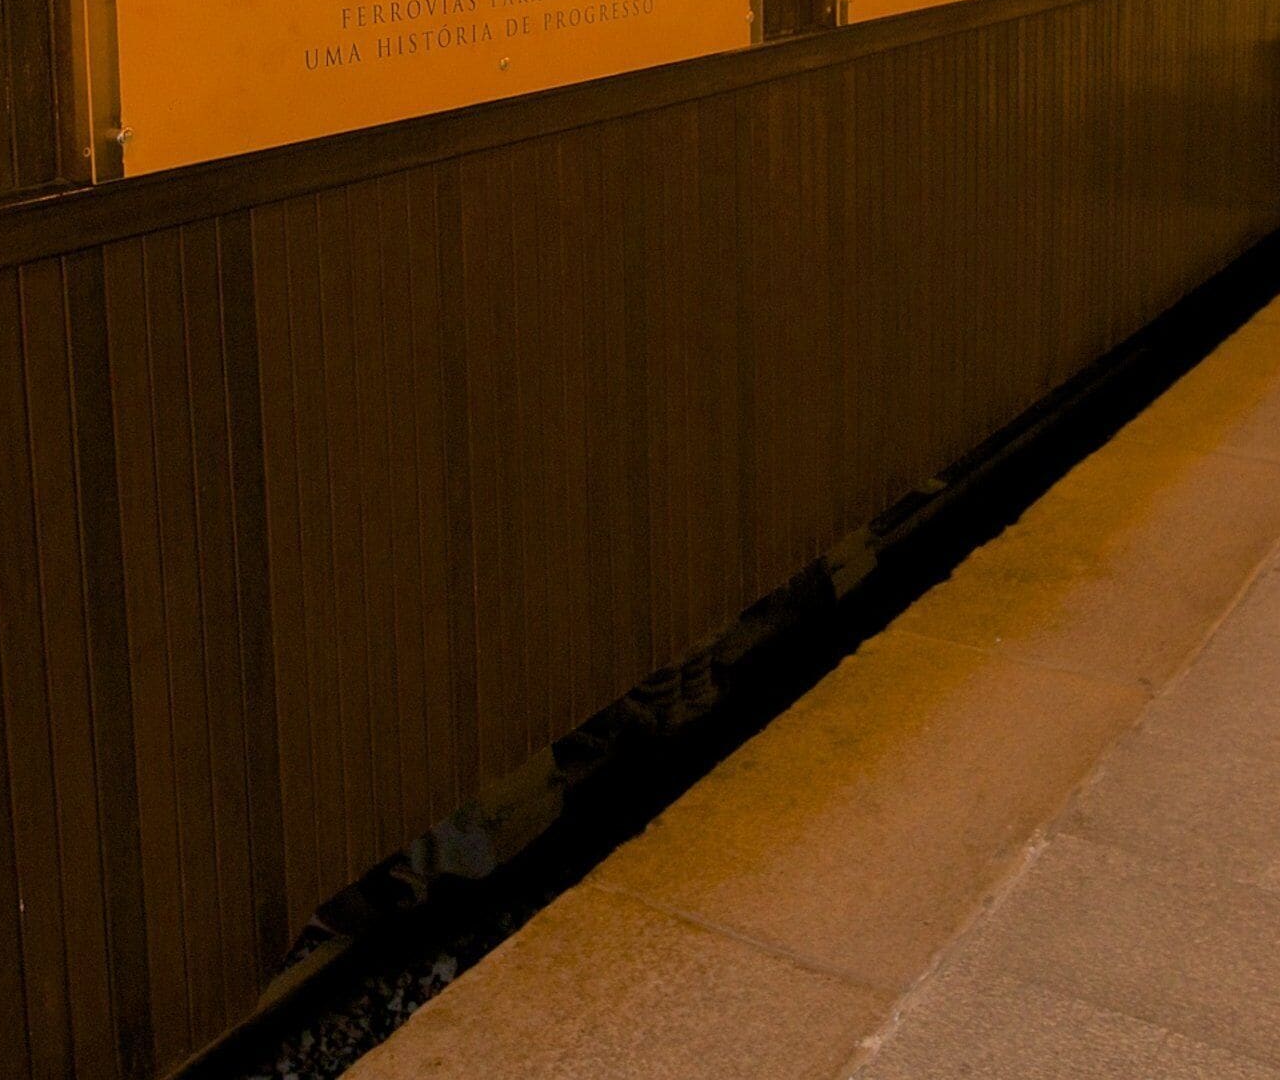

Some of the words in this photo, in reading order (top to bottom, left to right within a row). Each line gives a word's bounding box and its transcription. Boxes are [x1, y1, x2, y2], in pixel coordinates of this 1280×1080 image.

[305, 42, 361, 71] UMA
[378, 24, 493, 58] HISTÓRIA
[506, 15, 531, 37] DE
